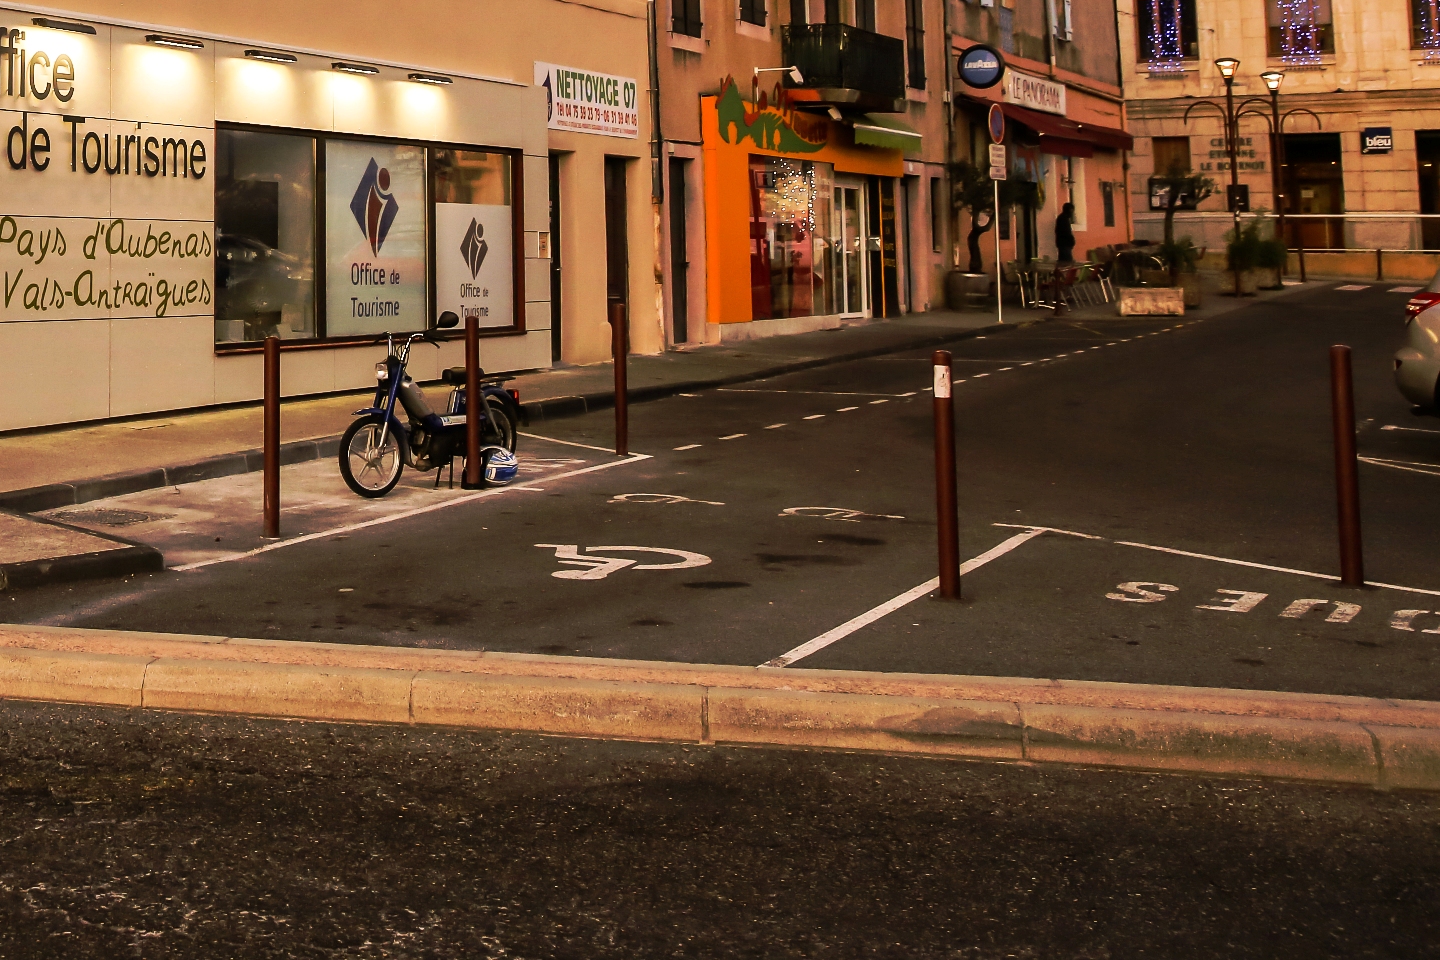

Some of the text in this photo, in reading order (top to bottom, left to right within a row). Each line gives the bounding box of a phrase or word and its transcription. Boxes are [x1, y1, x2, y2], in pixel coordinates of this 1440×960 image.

[964, 60, 997, 69] LAVAZZA
[556, 69, 636, 110] NETTOYAGE 07
[1013, 76, 1060, 109] LE PANORAMA
[573, 105, 579, 119] 75
[7, 112, 207, 179] de Tourisme
[1210, 138, 1252, 146] CERE
[1366, 136, 1391, 147] bleu
[82, 218, 212, 260] d'Aubenas
[351, 262, 400, 285] Office de
[460, 283, 489, 298] Office de
[350, 296, 400, 318] Tourisme
[460, 303, 489, 318] Tourisme
